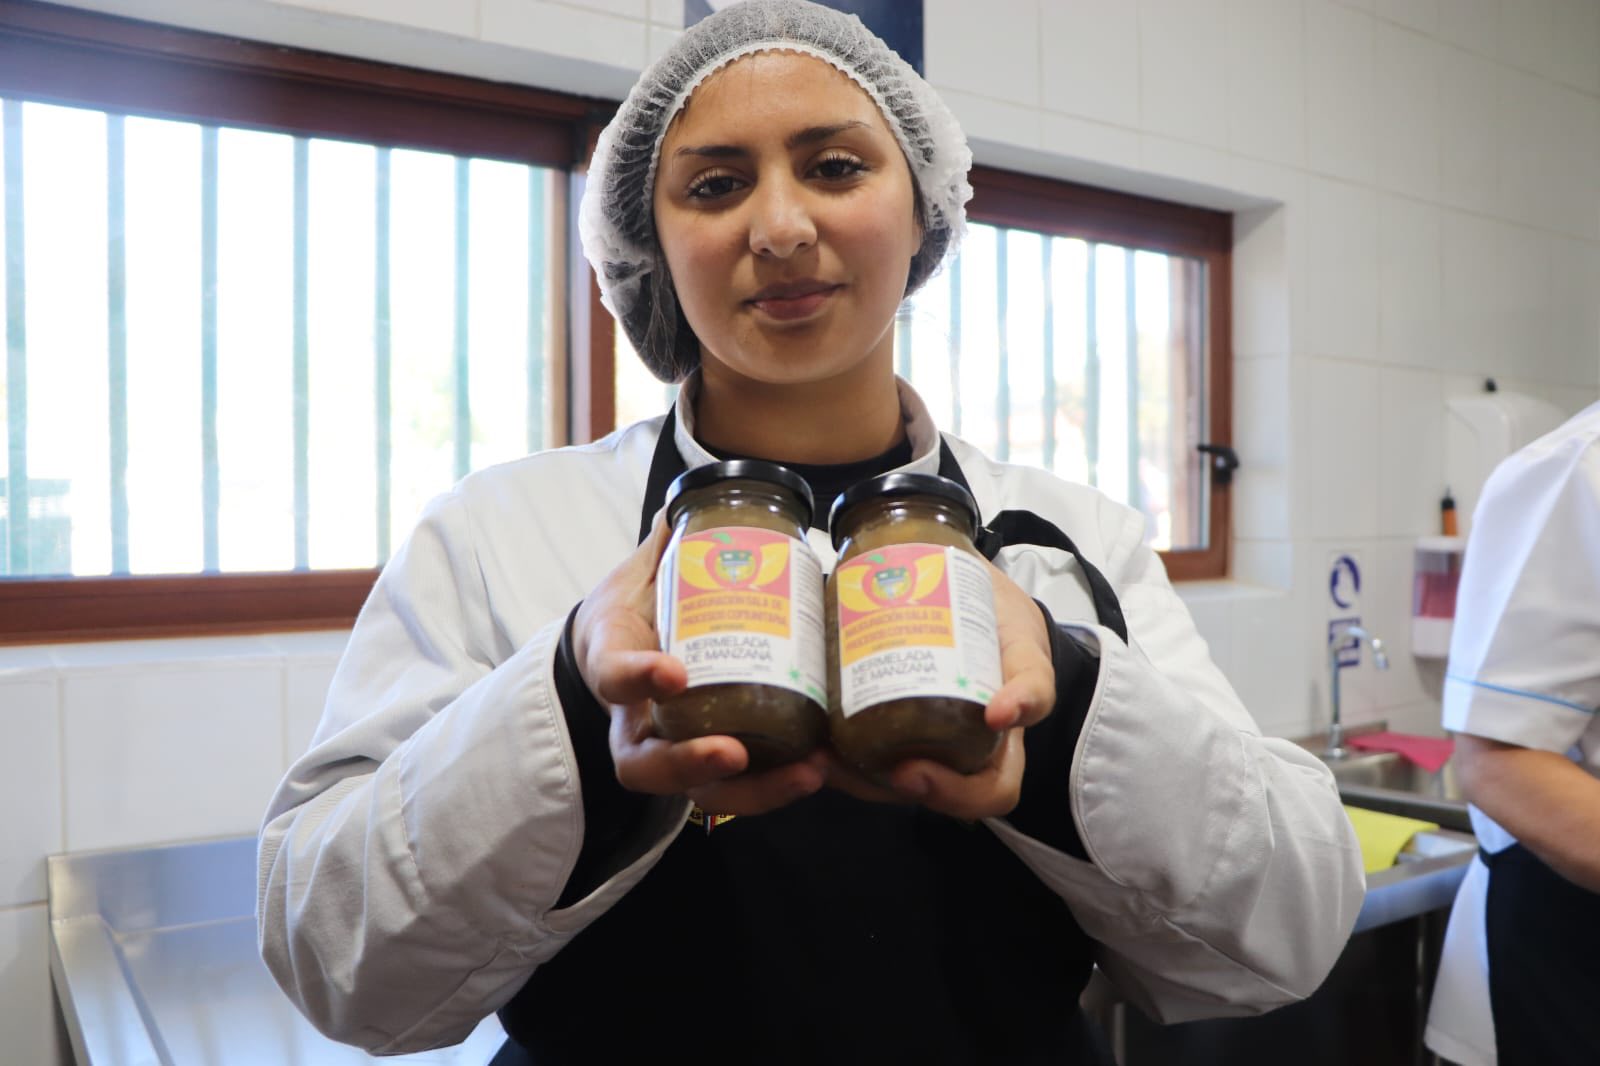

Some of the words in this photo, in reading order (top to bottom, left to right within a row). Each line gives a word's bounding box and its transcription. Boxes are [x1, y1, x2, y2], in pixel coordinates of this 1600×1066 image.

[685, 636, 771, 652] MERMELADA
[685, 653, 700, 665] DE
[703, 648, 774, 662] MANZANA
[852, 650, 935, 674] MERMELADA
[852, 675, 866, 688] DE
[870, 663, 939, 680] MANZANA
